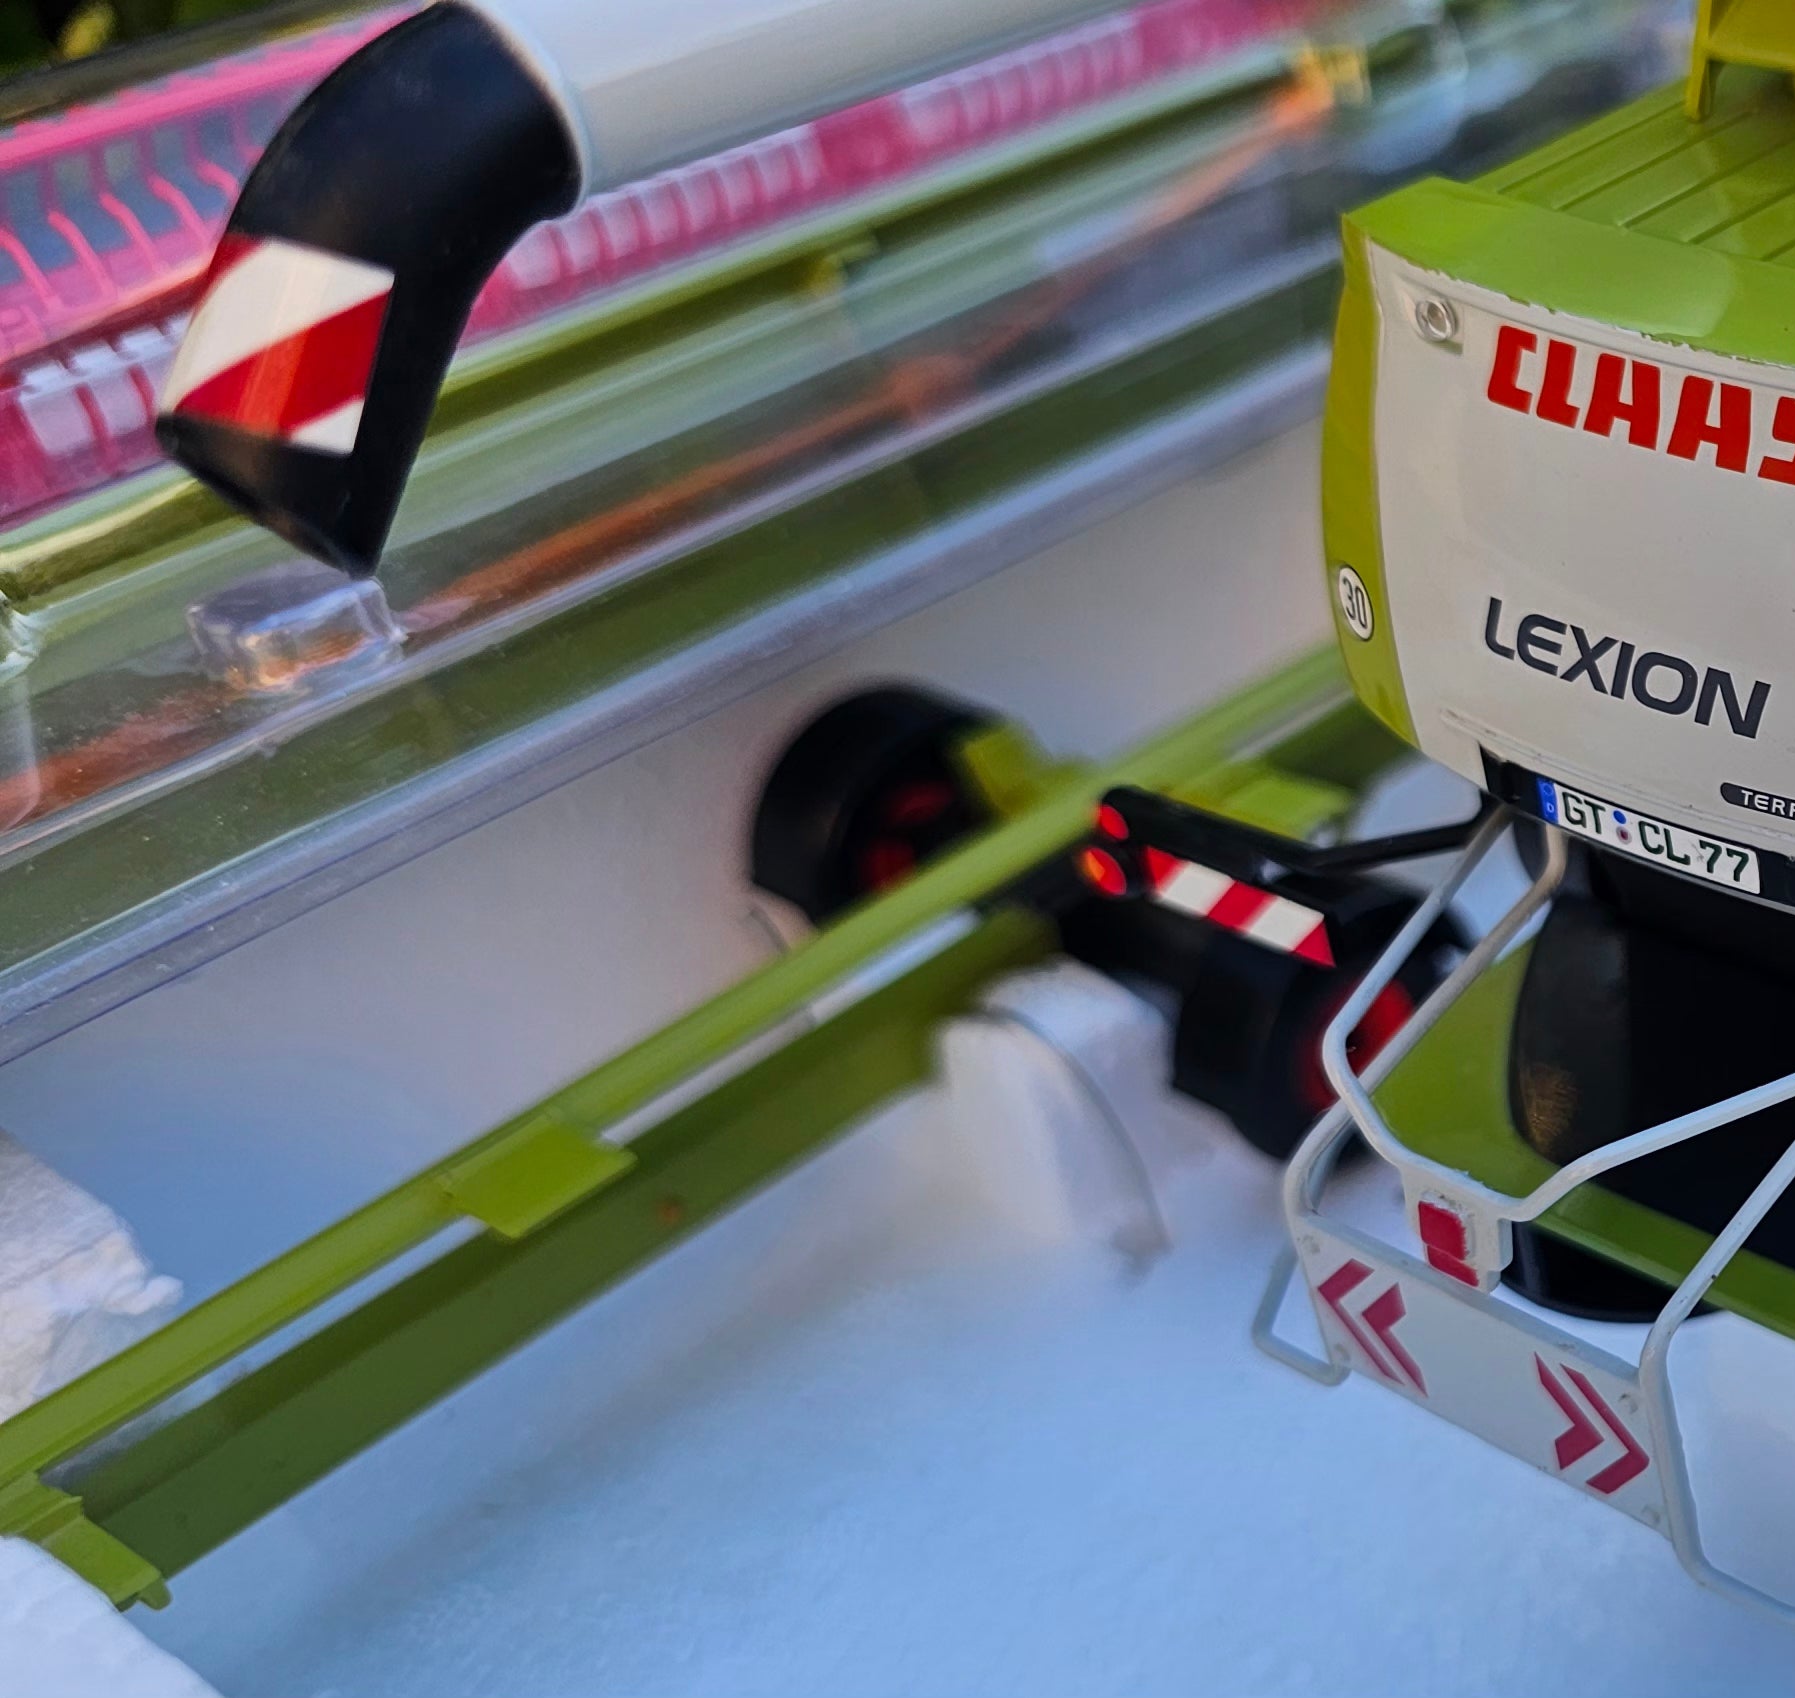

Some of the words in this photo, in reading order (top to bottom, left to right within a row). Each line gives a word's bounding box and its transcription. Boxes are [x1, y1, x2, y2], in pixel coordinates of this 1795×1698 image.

[1342, 576, 1369, 630] 30
[1484, 597, 1771, 738] LEXION
[1562, 791, 1606, 836] GT
[1640, 820, 1691, 866] CL
[1699, 839, 1751, 883] 77
